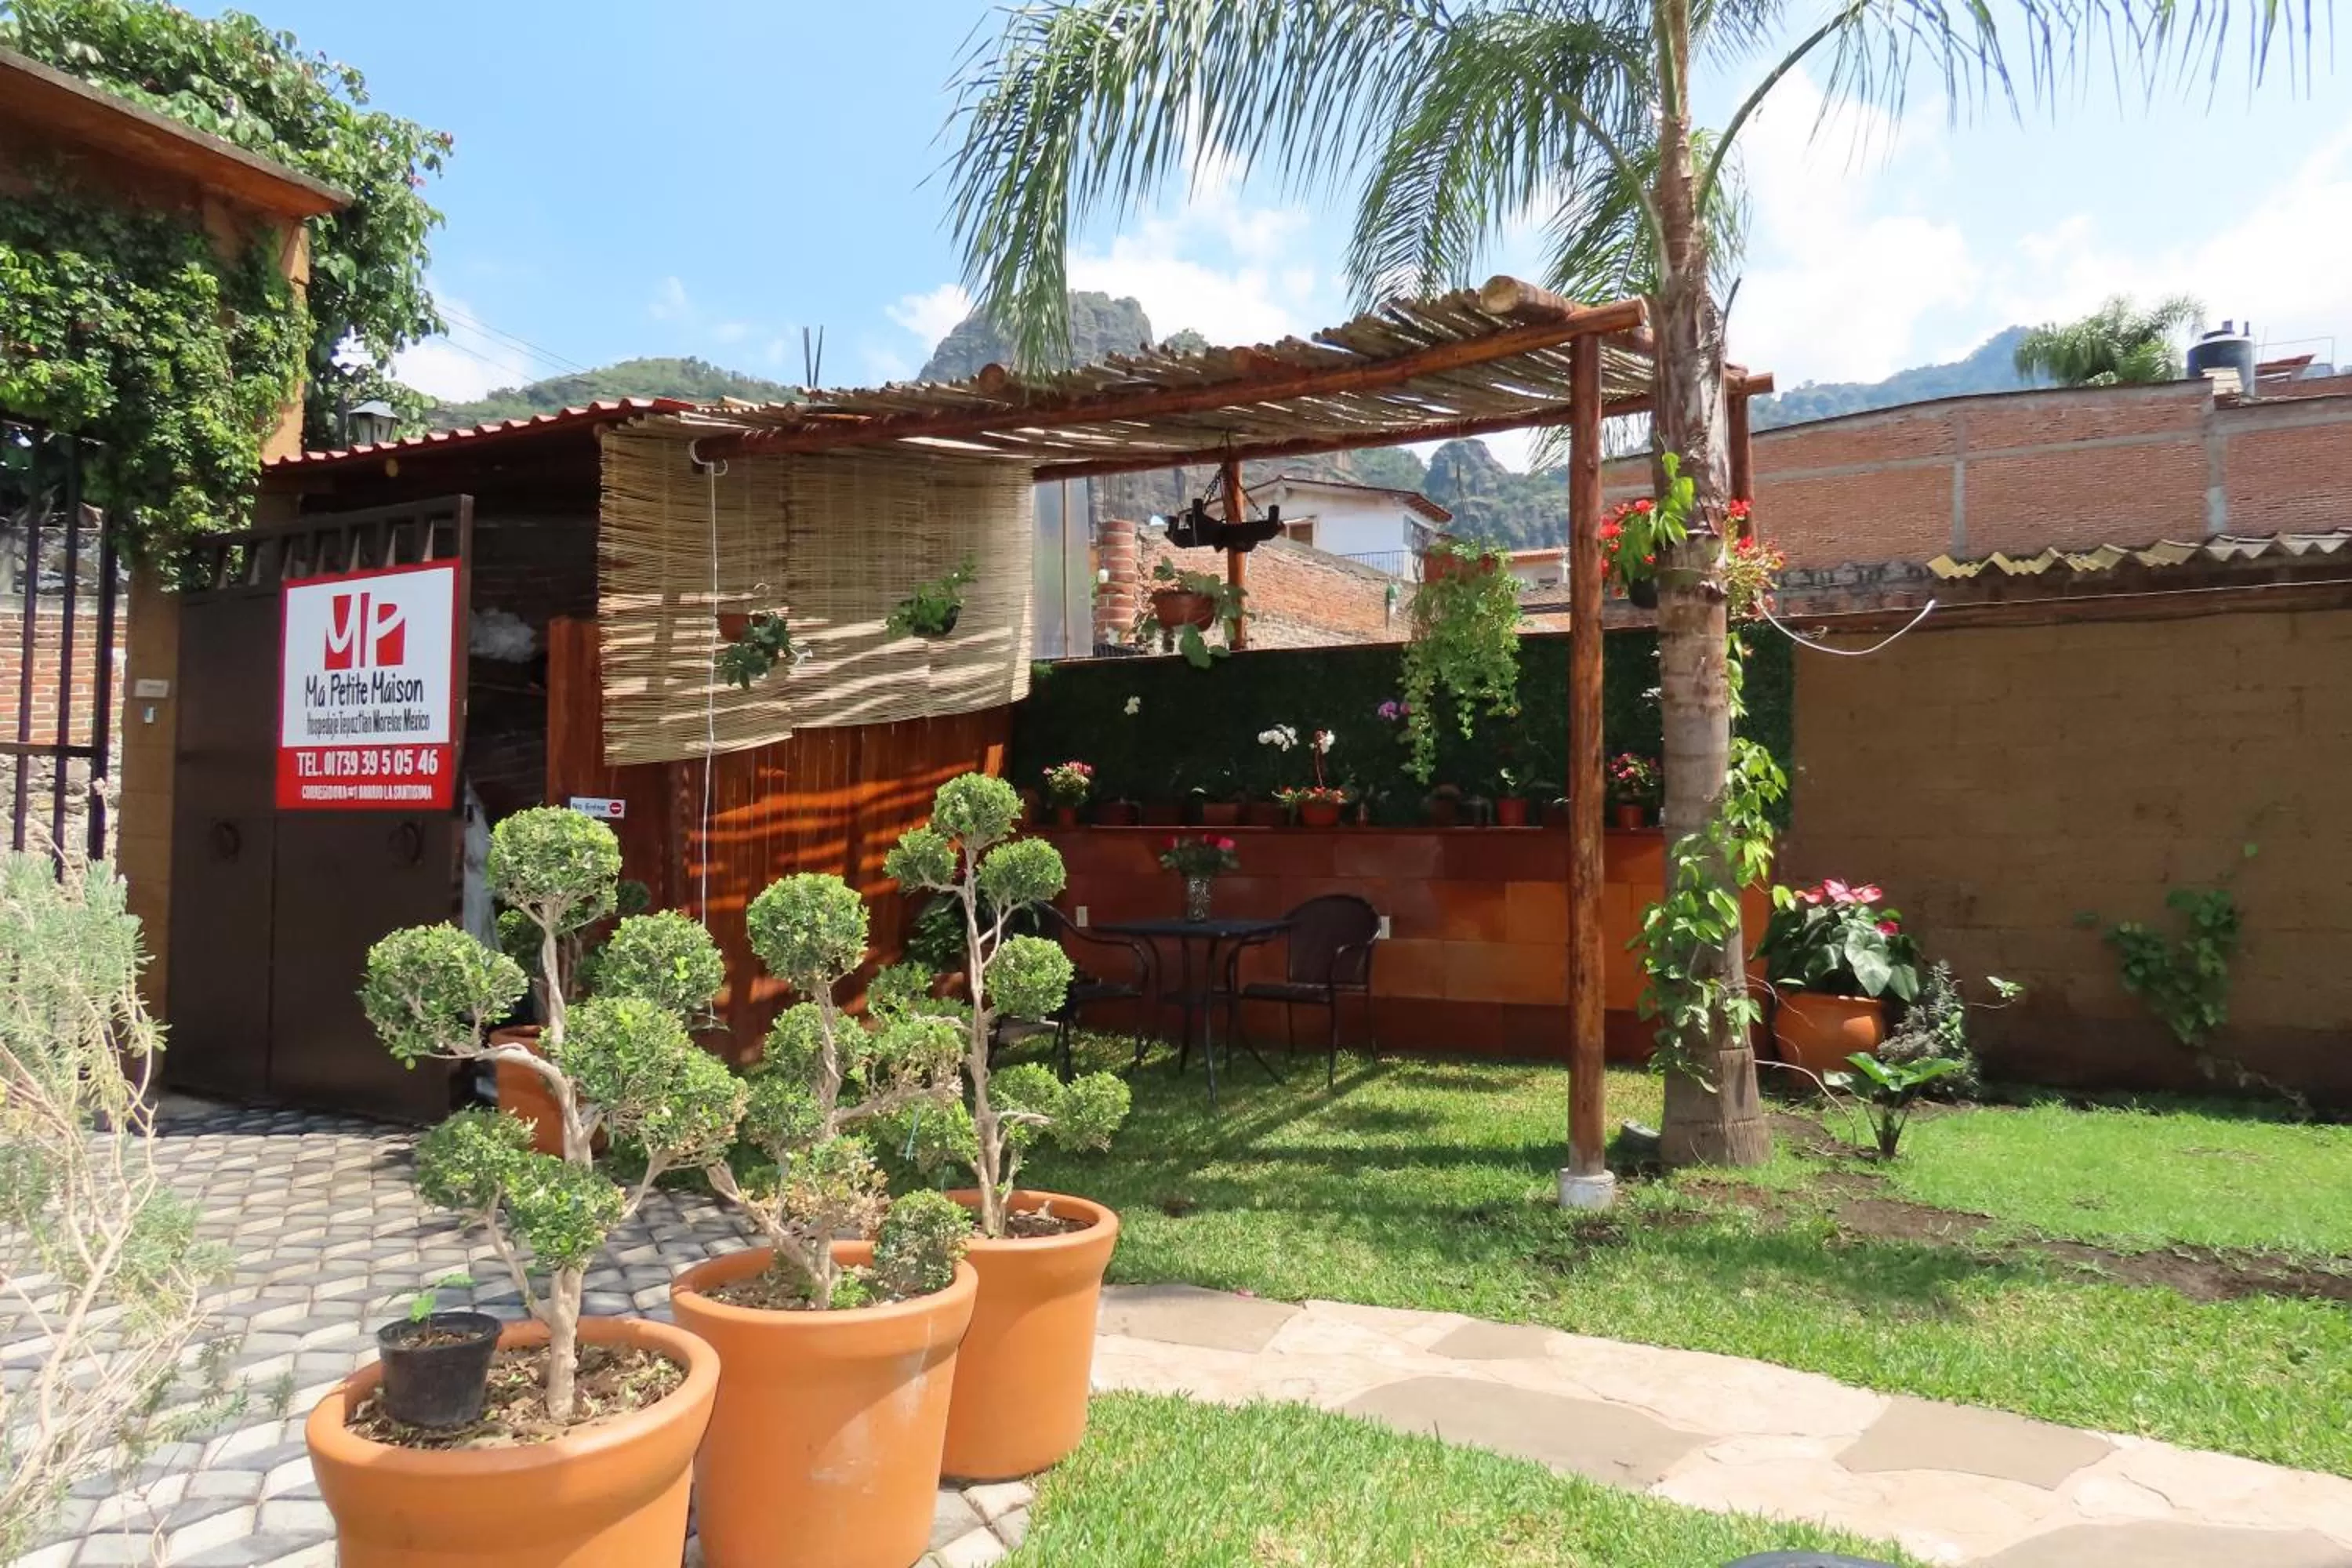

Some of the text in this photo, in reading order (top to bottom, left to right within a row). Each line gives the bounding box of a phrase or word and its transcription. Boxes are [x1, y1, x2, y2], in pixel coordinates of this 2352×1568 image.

[305, 670, 423, 708] Ma Petite Maison
[296, 751, 322, 777] TEL.
[361, 750, 378, 775] 39
[382, 750, 391, 775] 5
[394, 749, 413, 775] 05
[417, 749, 438, 775] 46
